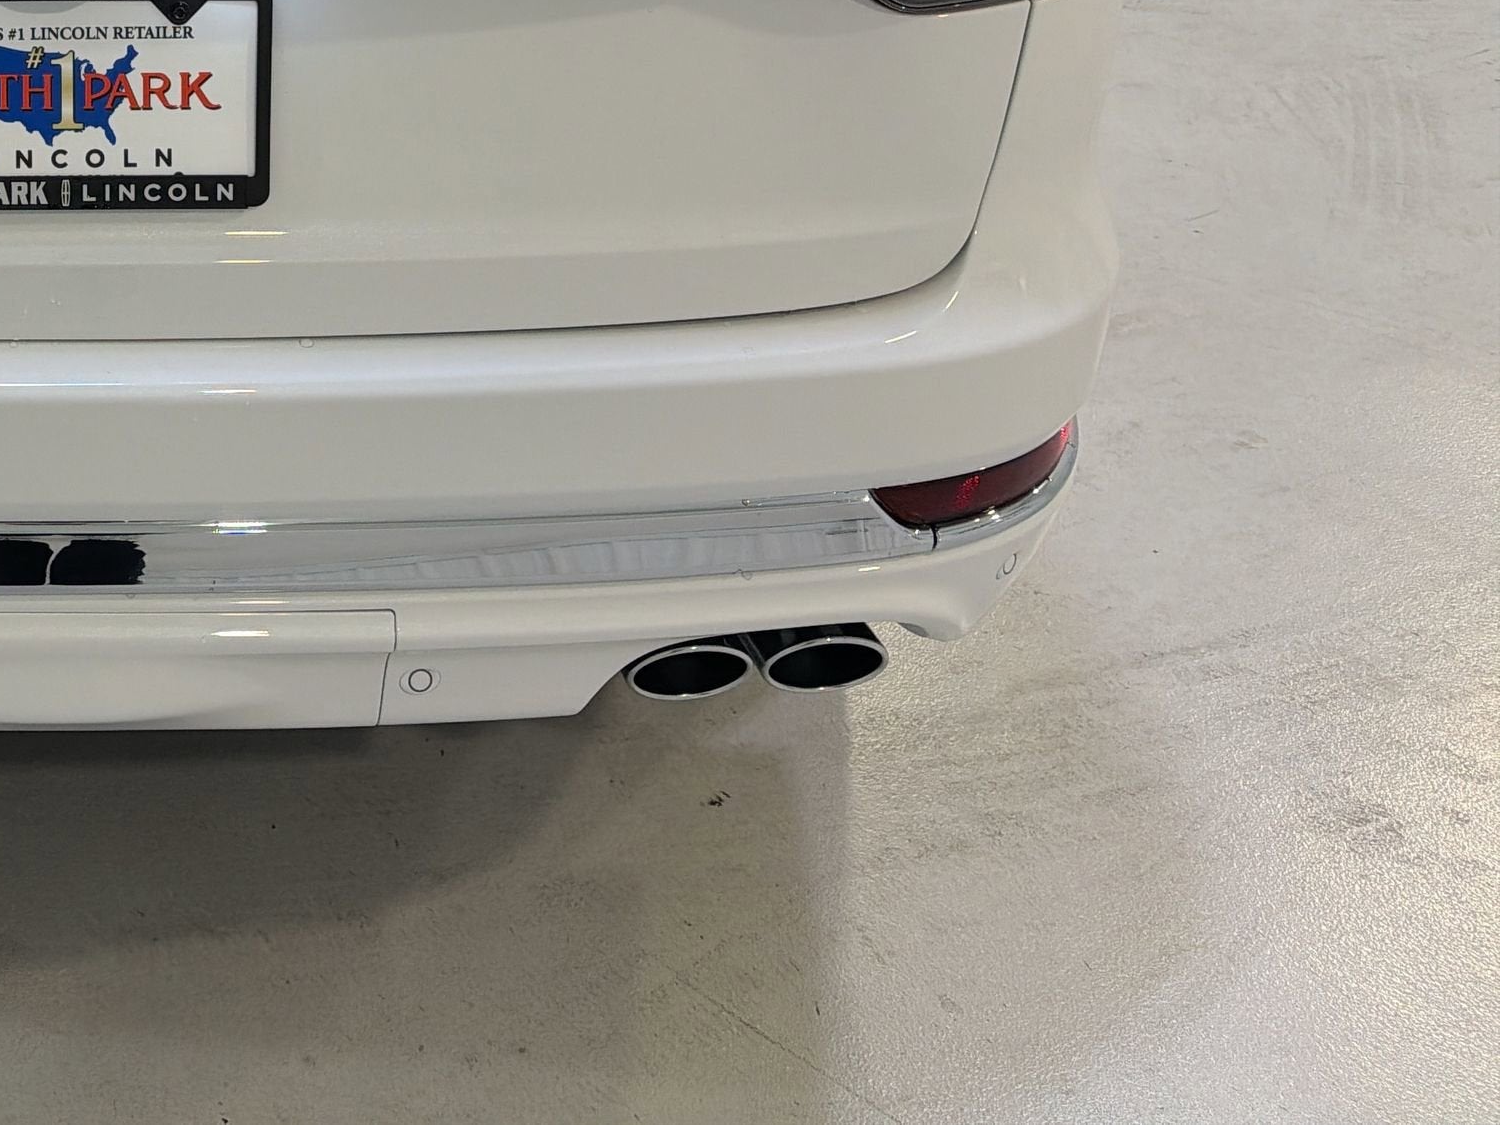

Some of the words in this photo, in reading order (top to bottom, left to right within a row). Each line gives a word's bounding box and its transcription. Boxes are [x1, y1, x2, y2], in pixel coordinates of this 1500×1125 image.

[8, 28, 25, 41] #1
[30, 26, 108, 41] LINCOLN
[112, 25, 194, 41] RETAILER
[83, 71, 222, 111] PARK
[82, 182, 235, 202] LINCOLN
